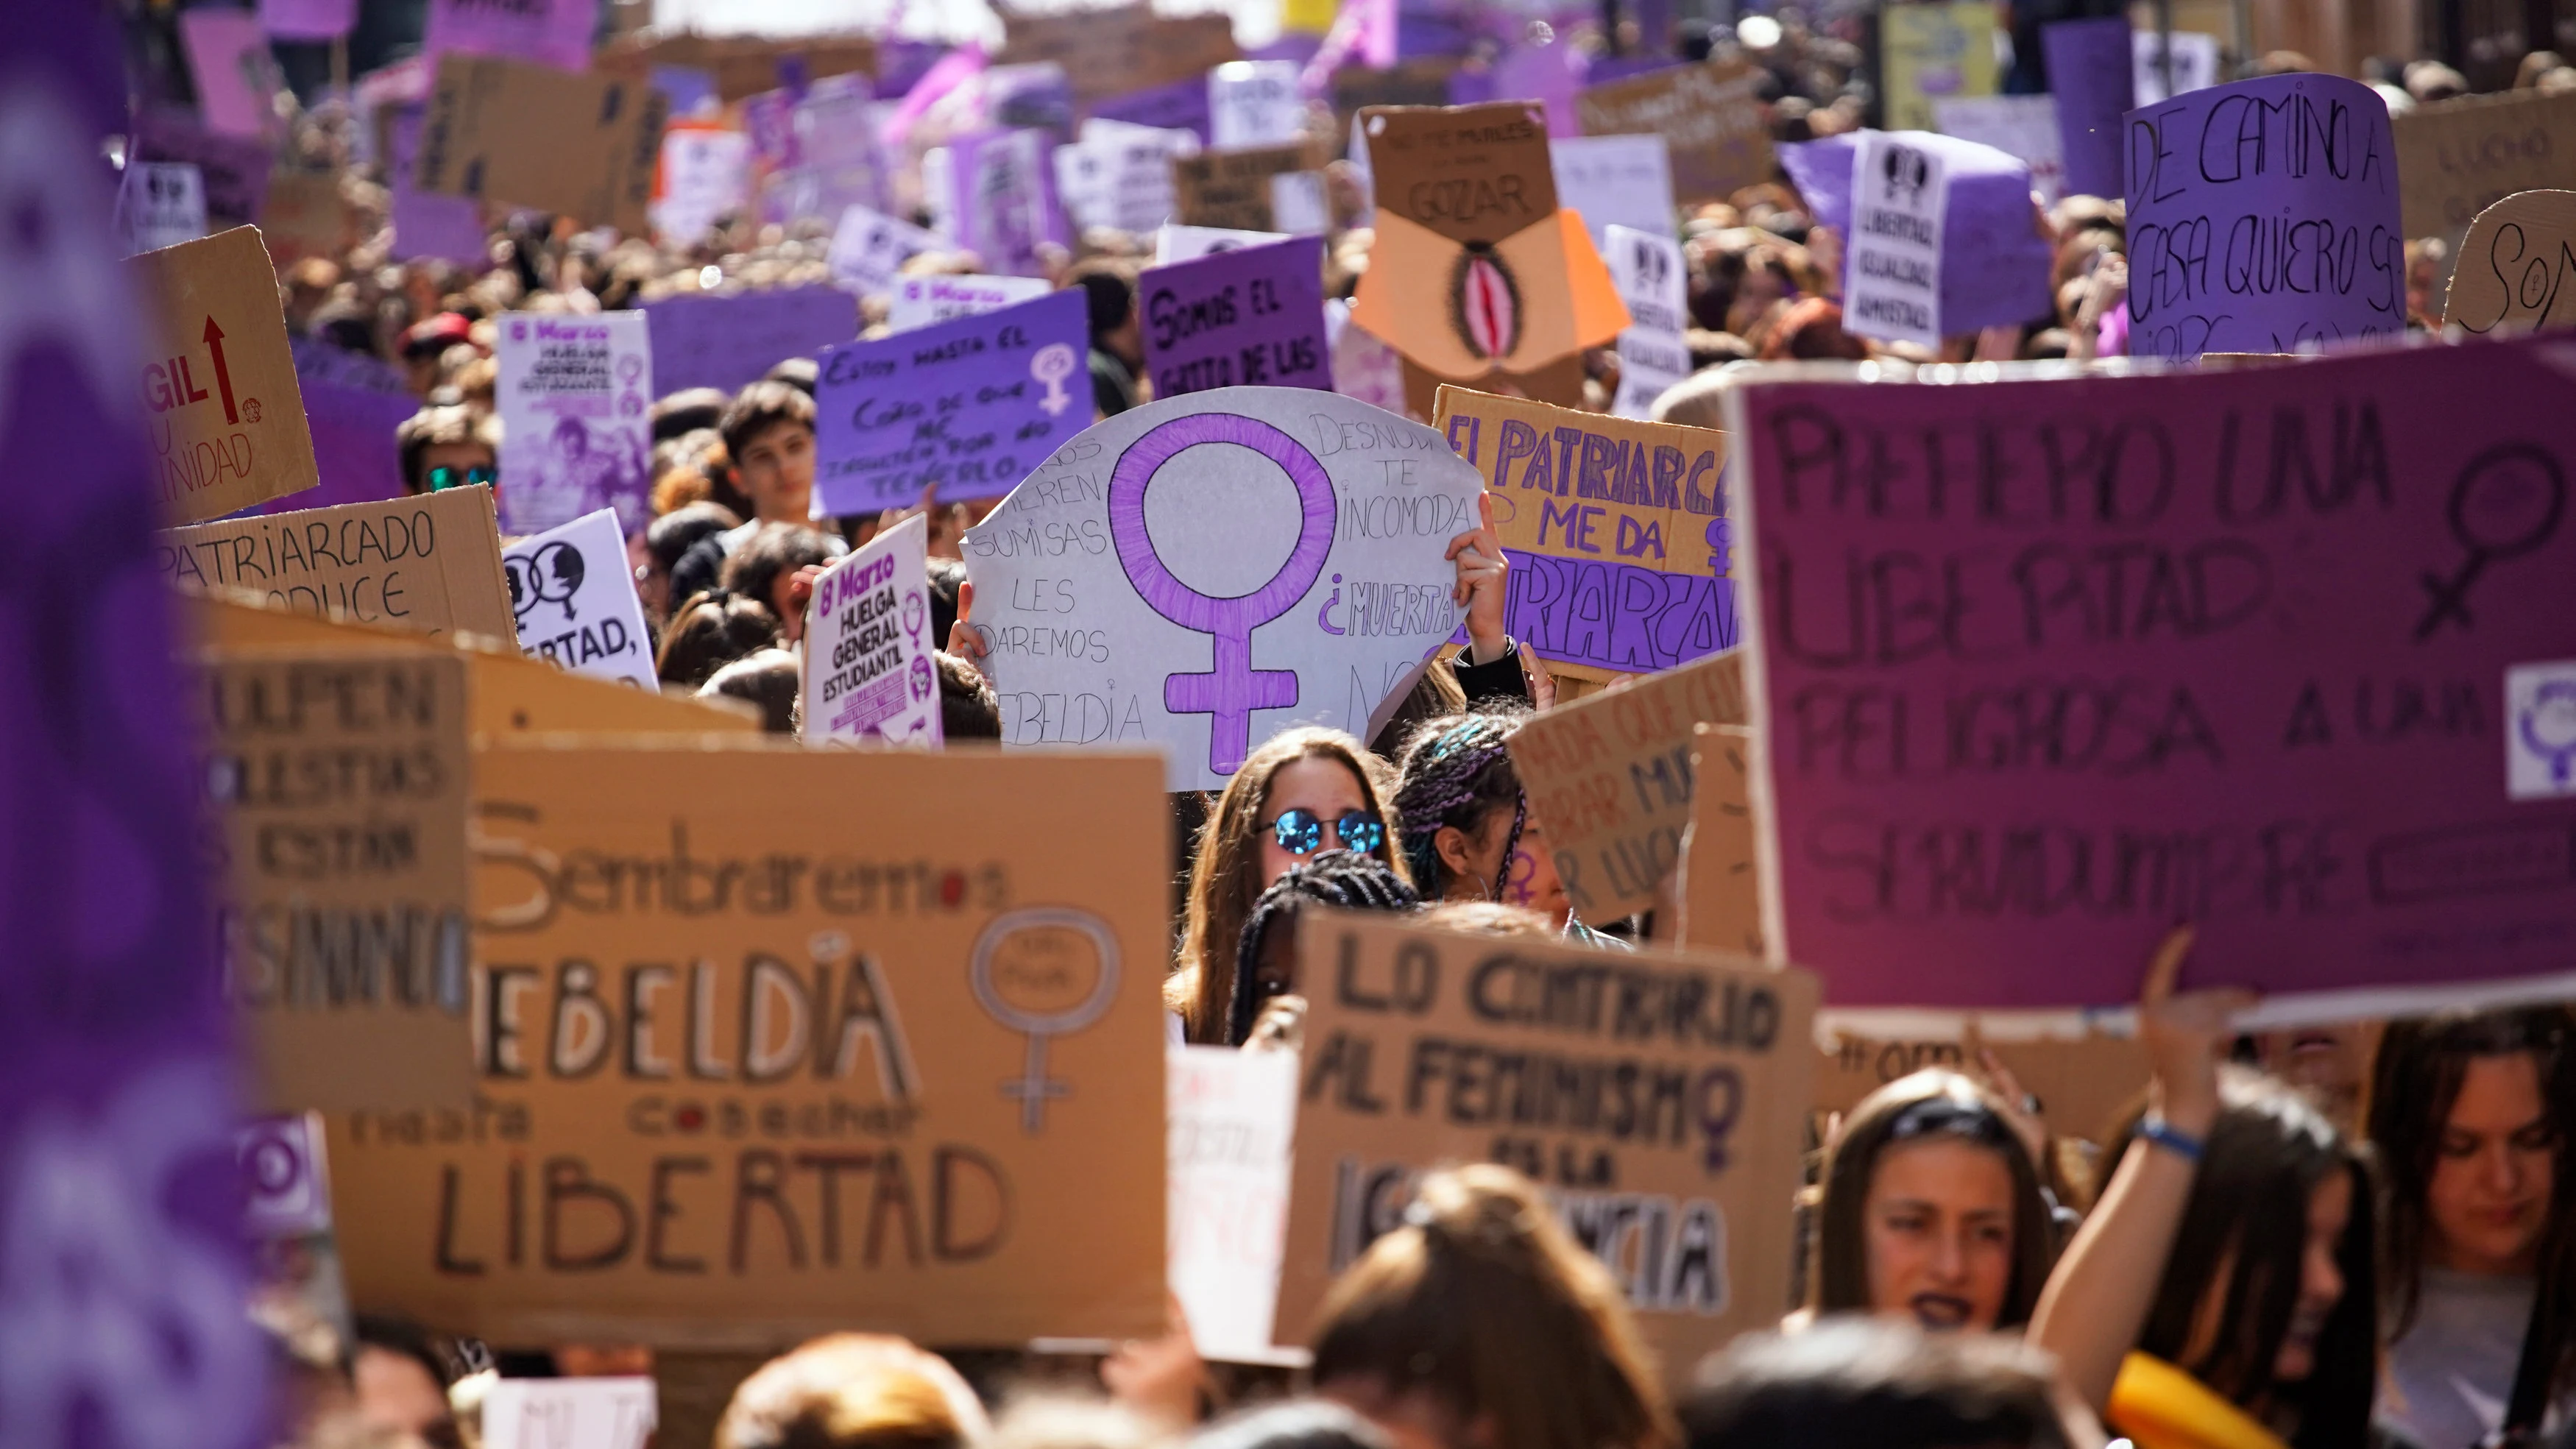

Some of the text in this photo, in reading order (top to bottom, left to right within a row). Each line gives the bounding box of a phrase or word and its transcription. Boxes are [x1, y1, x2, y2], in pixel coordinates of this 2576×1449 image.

[2129, 80, 2385, 218] DE CAMINO A
[2129, 215, 2210, 325] CASA
[2224, 207, 2358, 297] QUIERO
[913, 336, 986, 366] HASTA
[997, 325, 1030, 350] EL
[1150, 278, 1283, 351] SOMOS EL
[141, 355, 210, 414] GIL
[1240, 343, 1269, 383] DE
[1273, 336, 1317, 377] LAS
[1374, 458, 1419, 486] TE
[2215, 397, 2396, 525] UNA
[971, 518, 1107, 558] SUMISAS
[1342, 489, 1472, 542] INCOMODA
[1538, 497, 1666, 560] ME DA
[157, 510, 434, 587] PATRIARCADO
[819, 553, 895, 618] 8 Marzo
[840, 584, 898, 637] HUELGA
[1012, 578, 1075, 613] LES
[1761, 534, 2273, 668] LIBERTAD
[823, 645, 905, 703] ESTUDIANTIL
[832, 614, 900, 670] GENERAL
[1791, 674, 2227, 787] PELIGROSA
[2283, 677, 2335, 748] A
[475, 800, 1014, 933] Sembraremos
[1335, 933, 1783, 1054] LO CONTRARIO
[1306, 1030, 1389, 1114] AL
[434, 1141, 1016, 1277] LIBERTAD
